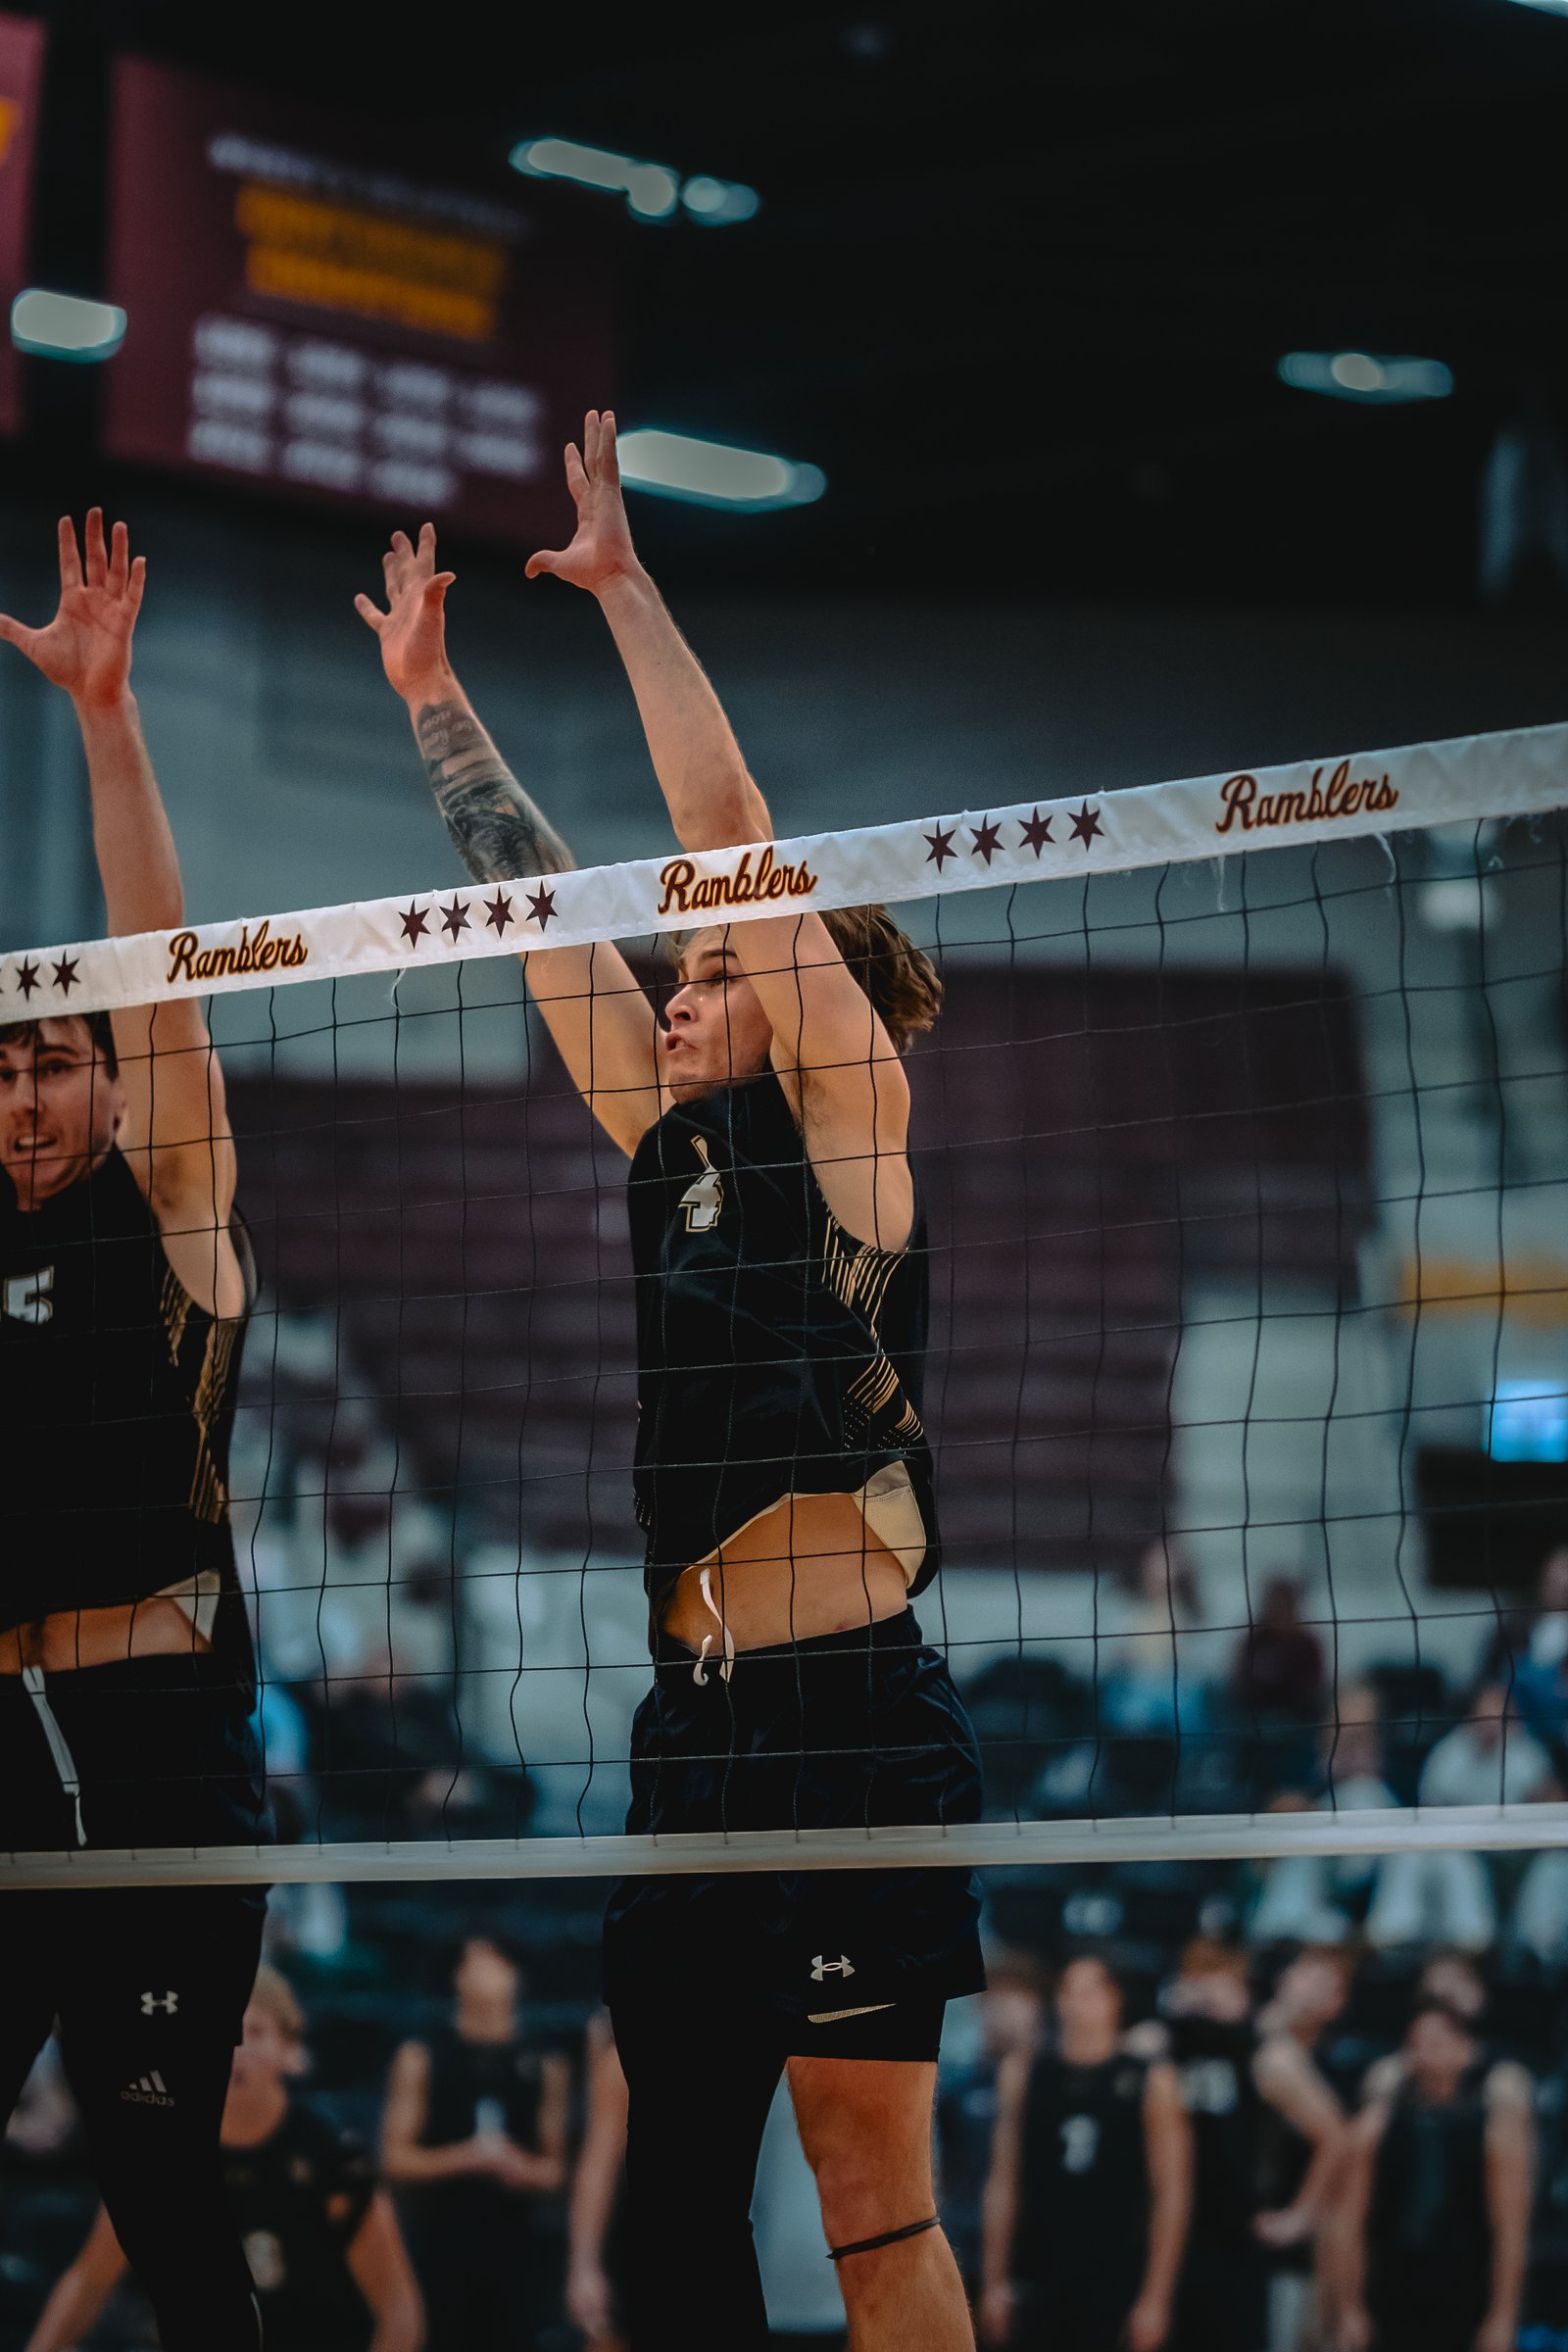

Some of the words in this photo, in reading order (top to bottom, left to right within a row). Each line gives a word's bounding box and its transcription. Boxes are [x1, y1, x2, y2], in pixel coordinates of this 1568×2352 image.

[1215, 759, 1399, 834] Ramblers
[657, 844, 819, 915] Ramblers
[167, 919, 309, 984] Ramblers
[120, 2089, 175, 2107] adidas
